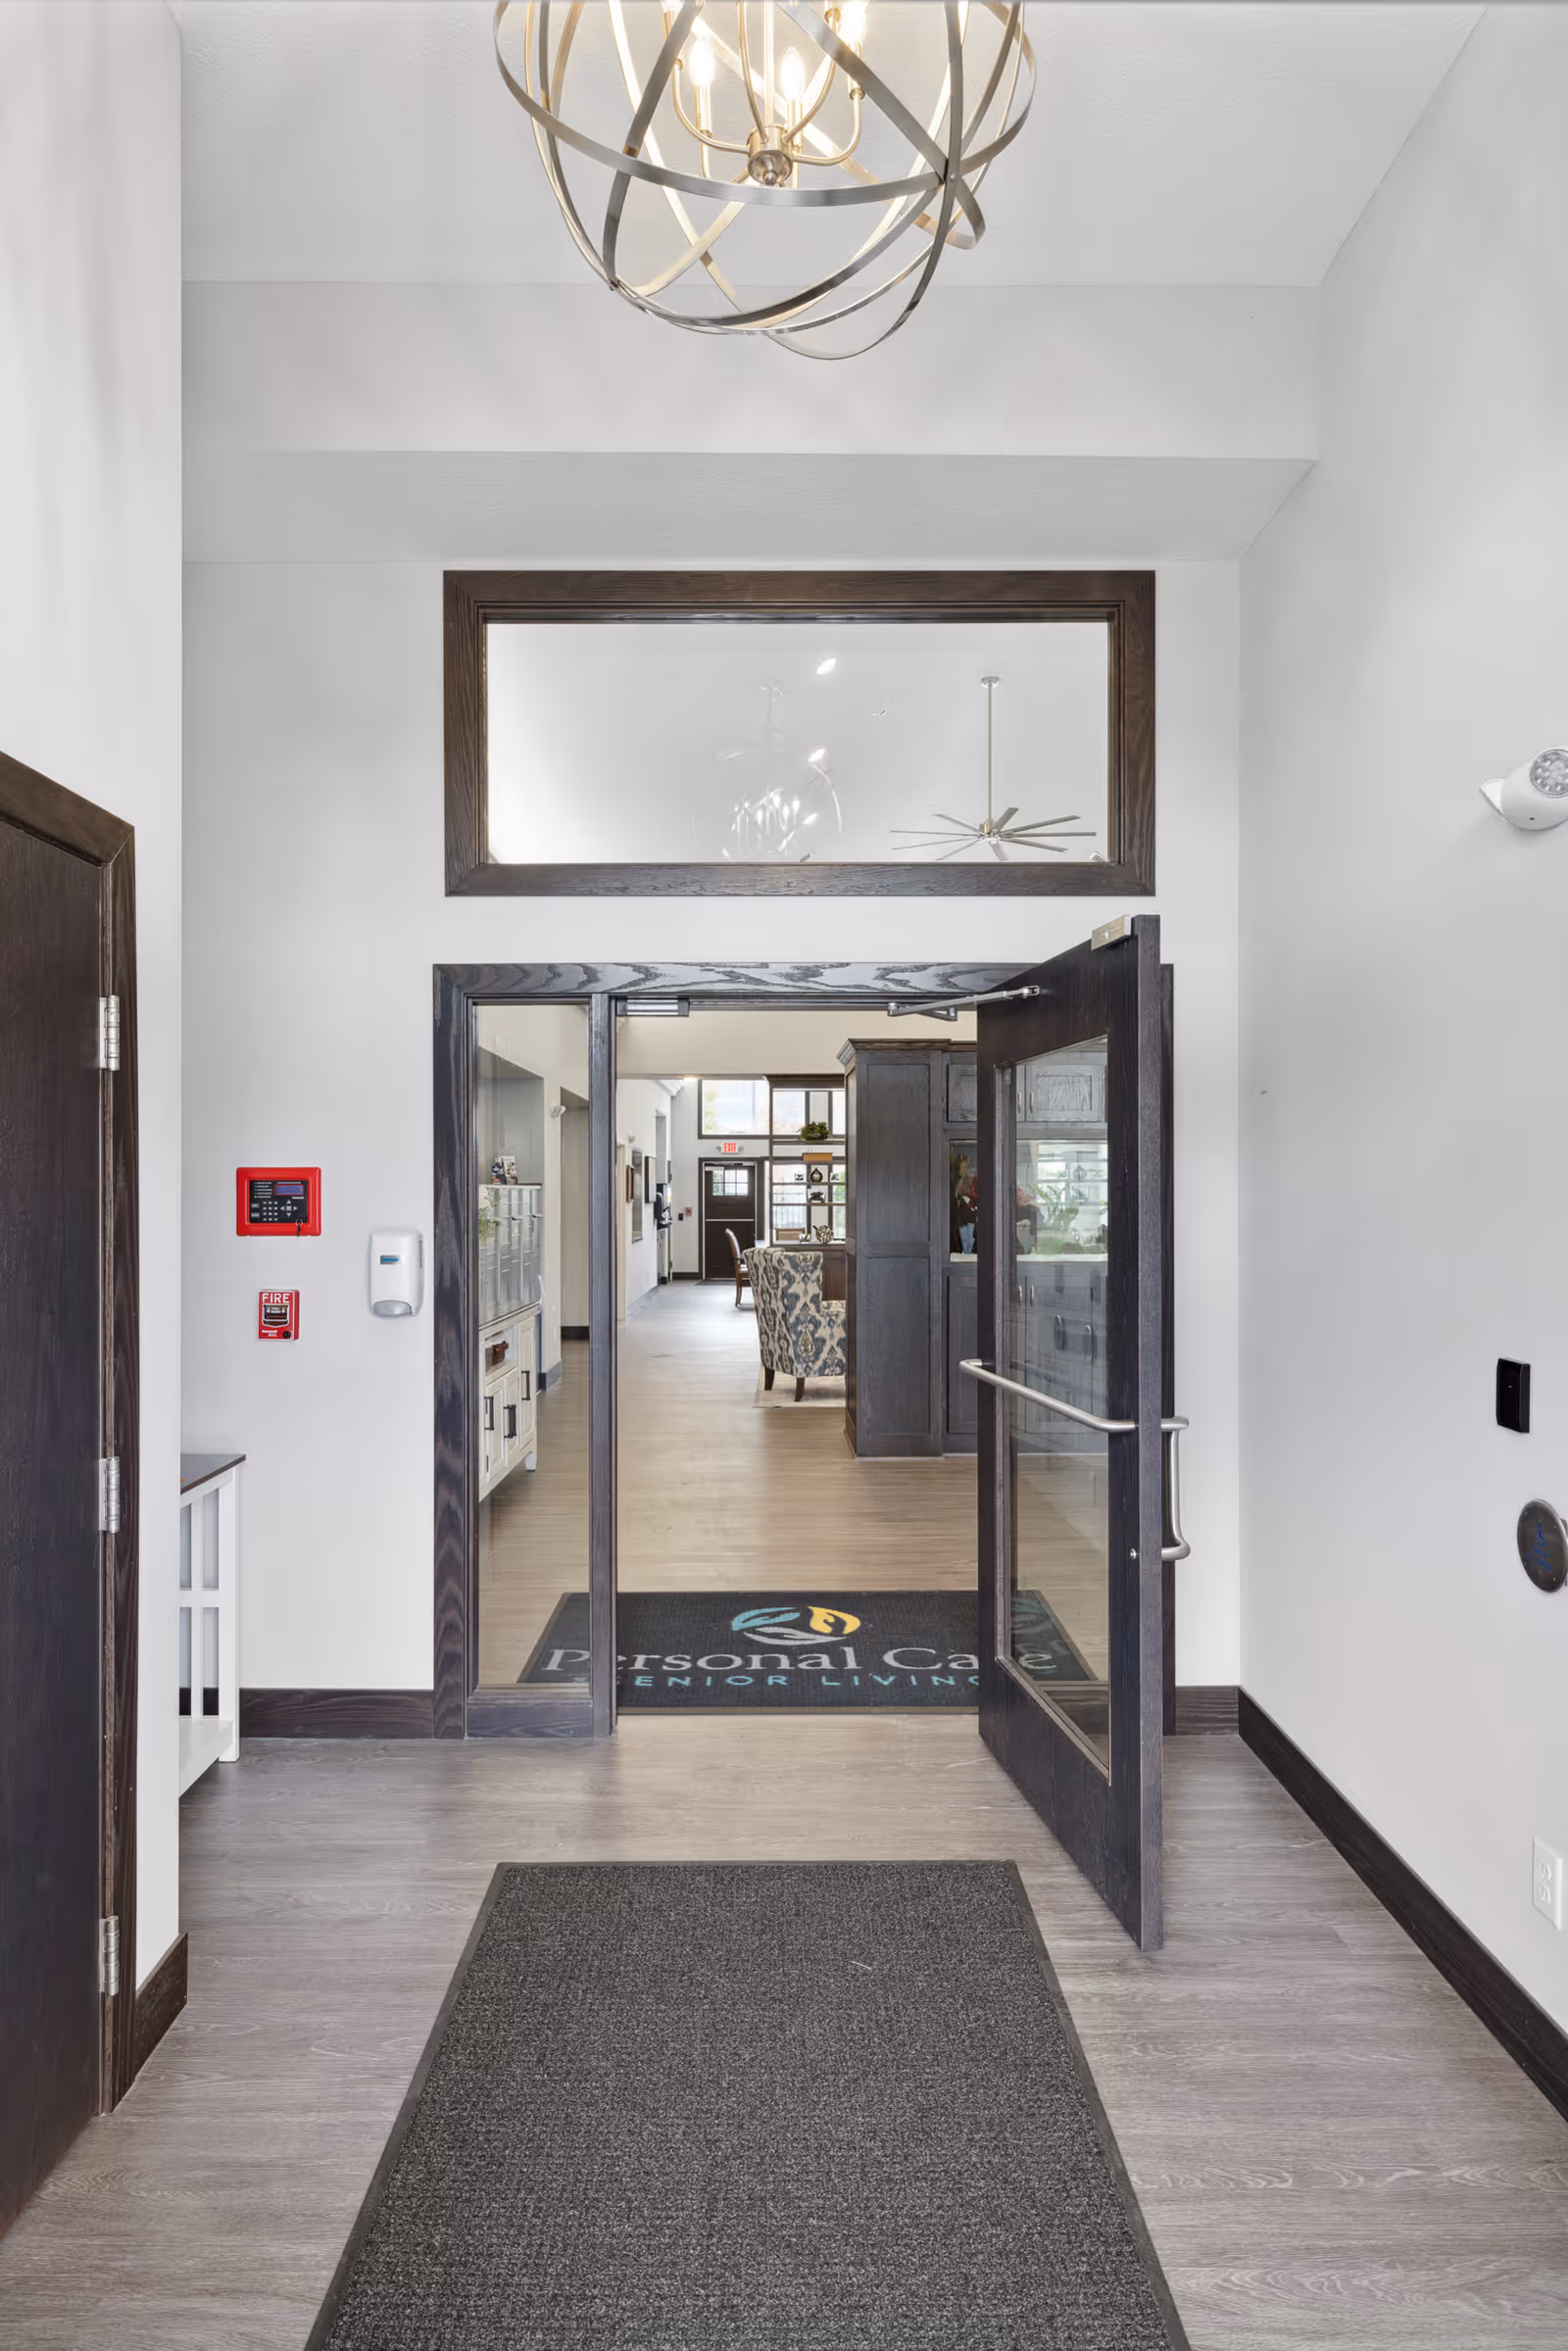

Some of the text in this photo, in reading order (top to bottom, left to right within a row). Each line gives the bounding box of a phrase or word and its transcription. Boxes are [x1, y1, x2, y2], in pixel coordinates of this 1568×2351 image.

[723, 1142, 737, 1153] EXIT
[262, 1293, 290, 1303] FIRE
[882, 1646, 1057, 1670] Cae
[615, 1674, 789, 1687] ENIOR
